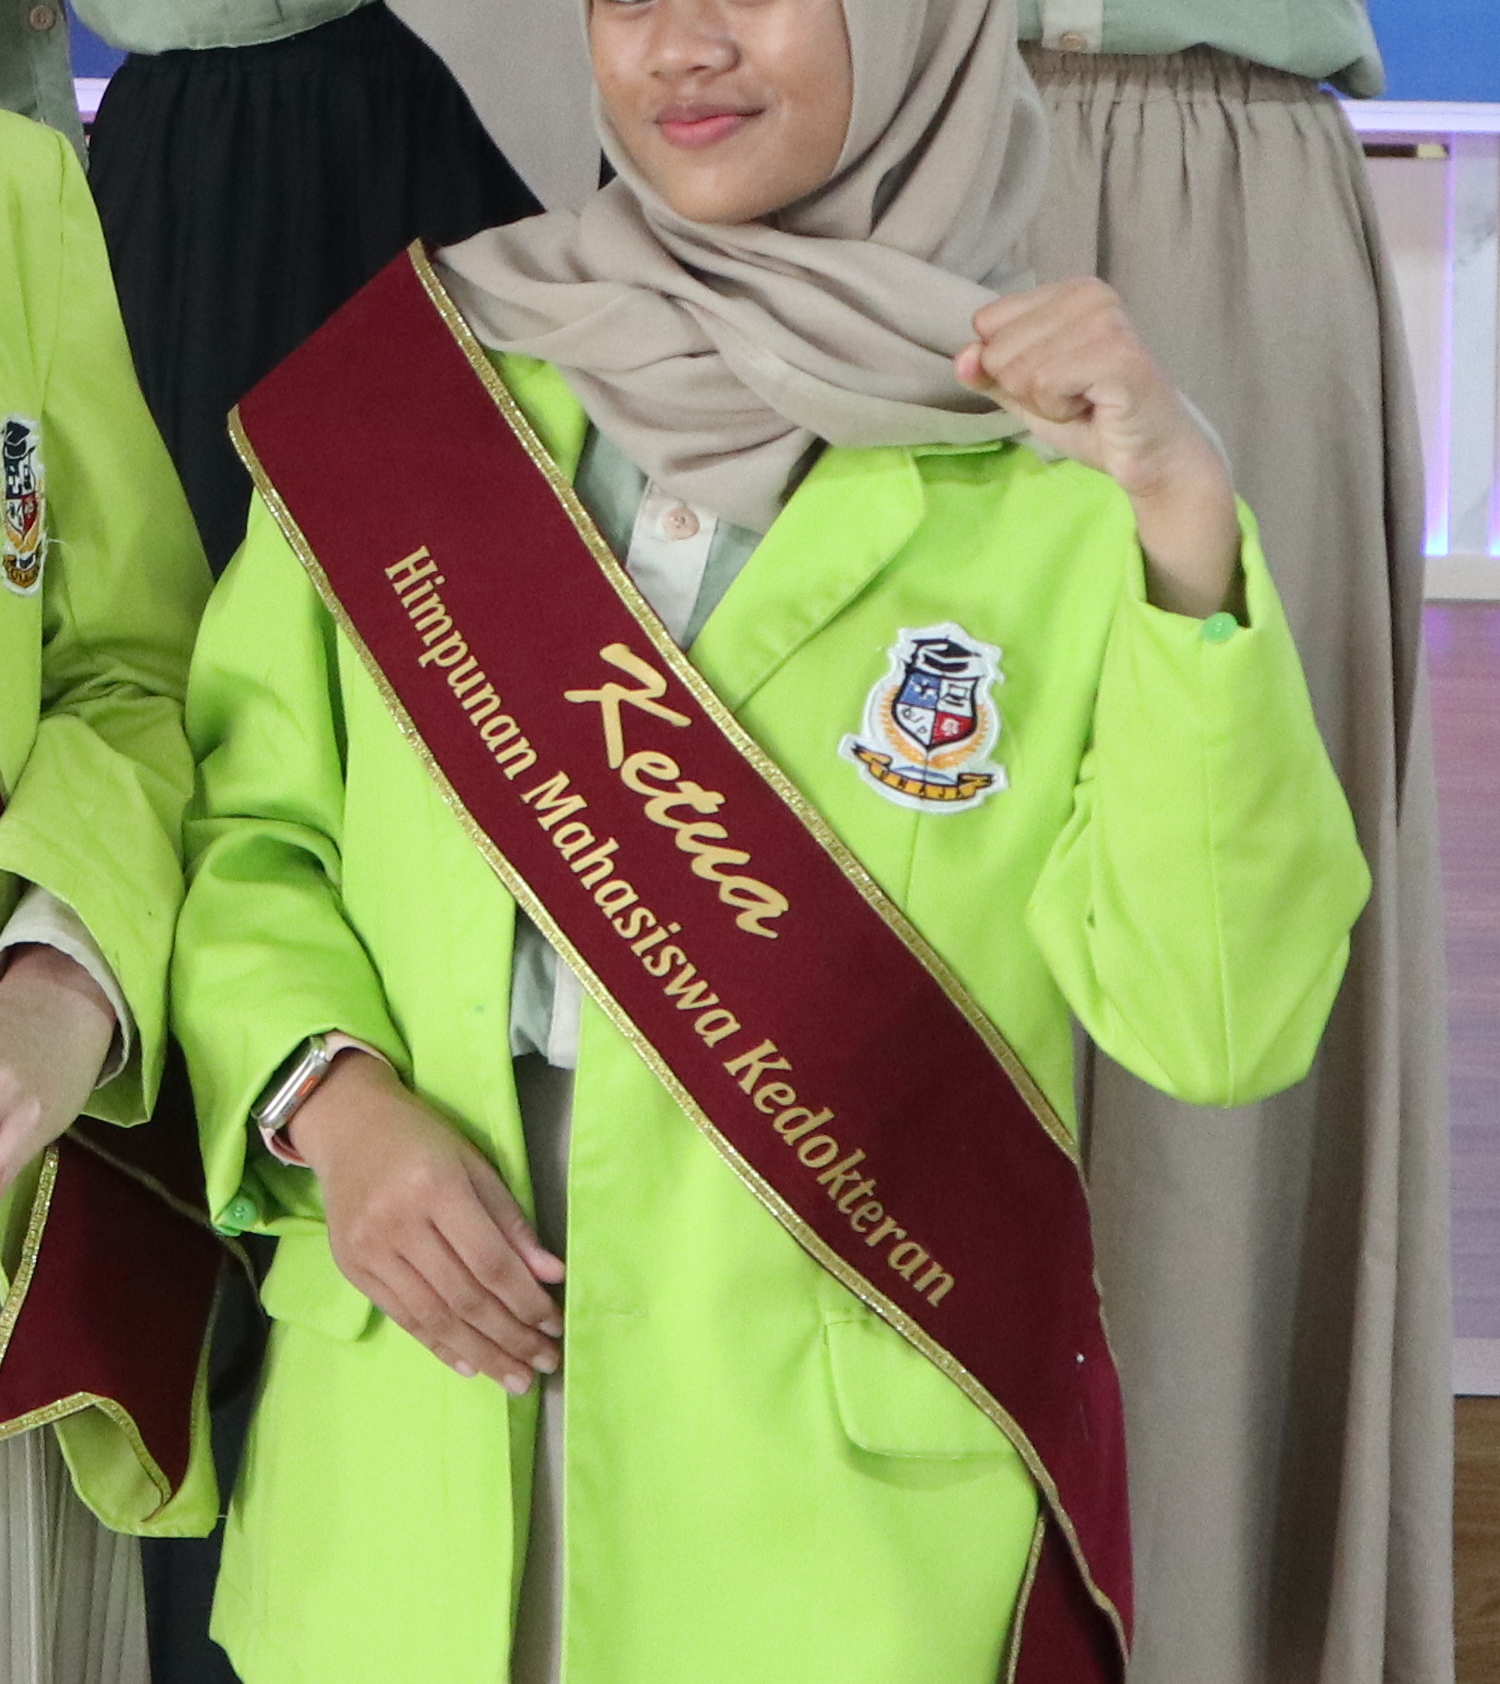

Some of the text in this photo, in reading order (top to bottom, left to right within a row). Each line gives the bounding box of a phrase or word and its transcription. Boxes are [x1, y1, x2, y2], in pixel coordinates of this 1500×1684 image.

[385, 545, 538, 782] Himpunan
[521, 771, 740, 1049] Mahasiswa
[723, 1038, 956, 1309] Kedokteran
[564, 642, 789, 938] Ketua
